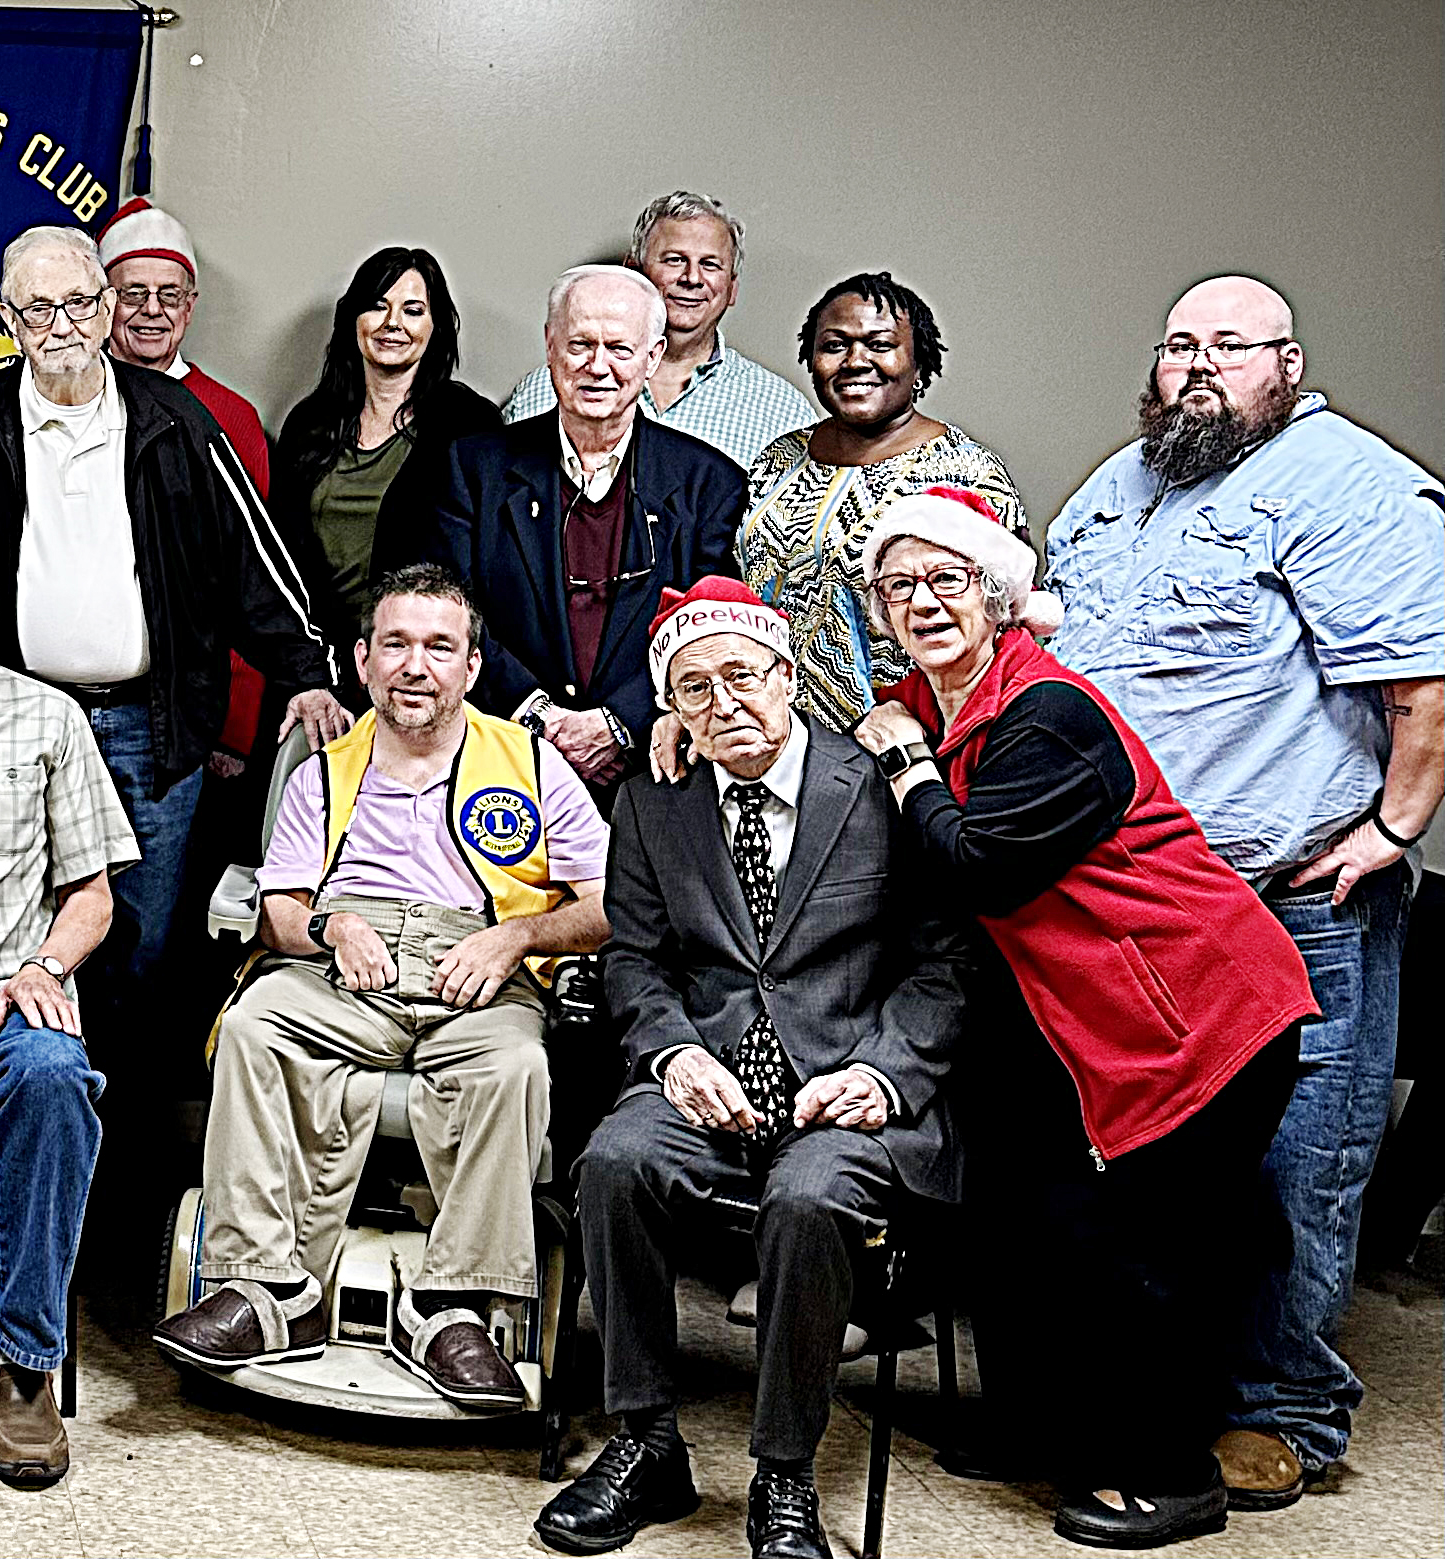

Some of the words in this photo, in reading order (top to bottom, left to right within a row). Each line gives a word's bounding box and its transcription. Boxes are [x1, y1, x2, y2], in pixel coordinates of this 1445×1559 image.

[19, 133, 109, 222] CLUB
[652, 632, 670, 666] No
[478, 795, 519, 808] LIONS
[491, 810, 513, 834] L
